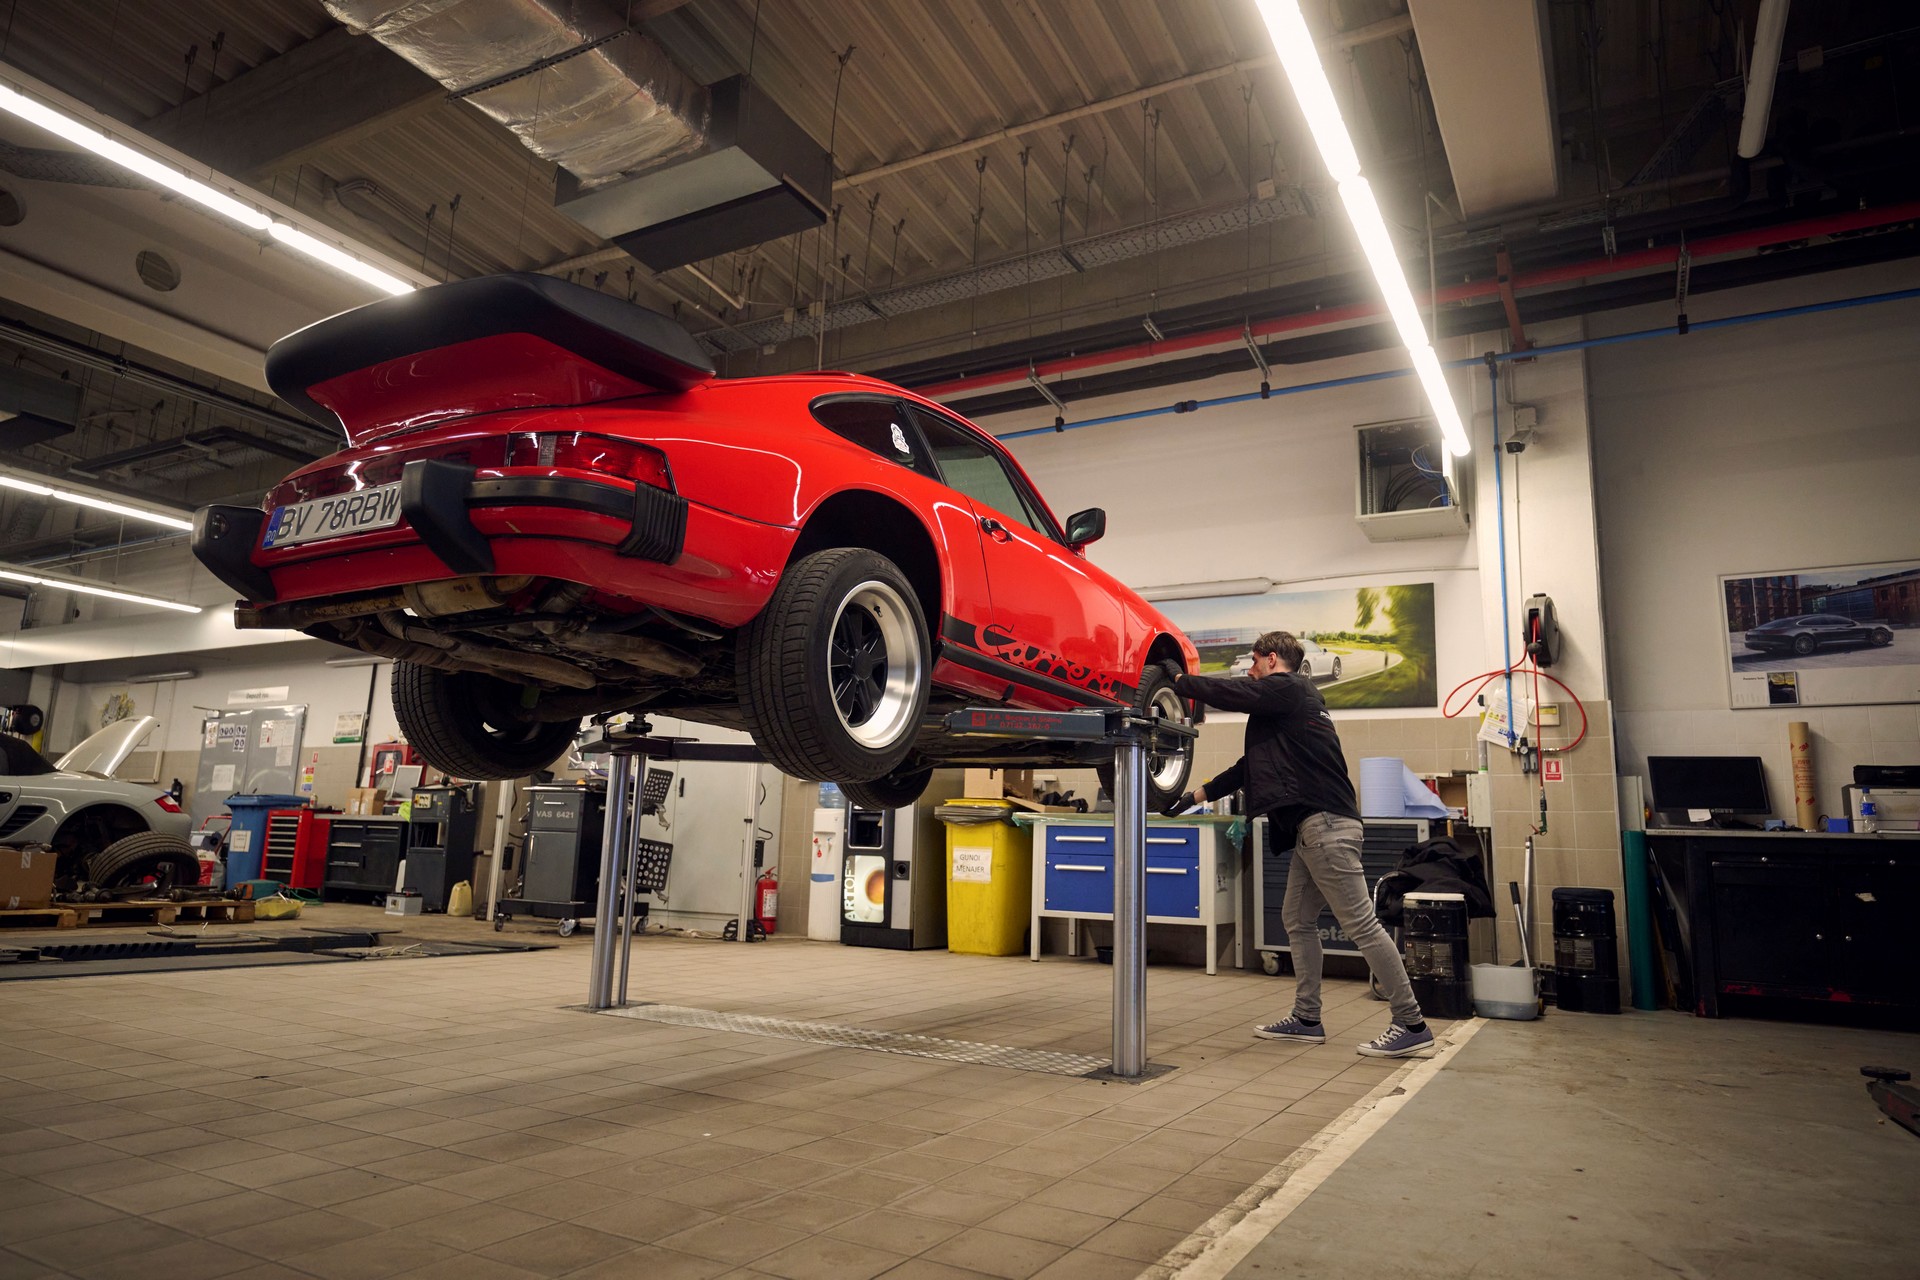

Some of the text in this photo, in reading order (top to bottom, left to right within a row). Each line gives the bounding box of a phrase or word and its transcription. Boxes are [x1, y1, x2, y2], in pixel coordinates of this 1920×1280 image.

[275, 504, 313, 540] BV
[315, 486, 401, 534] 78RBW
[265, 530, 277, 542] RO
[1193, 637, 1237, 645] PORSCHE
[974, 624, 1117, 699] Carrera
[536, 810, 574, 819] VAS 6421
[959, 853, 981, 861] GUNOI
[955, 864, 985, 873] MENAJER
